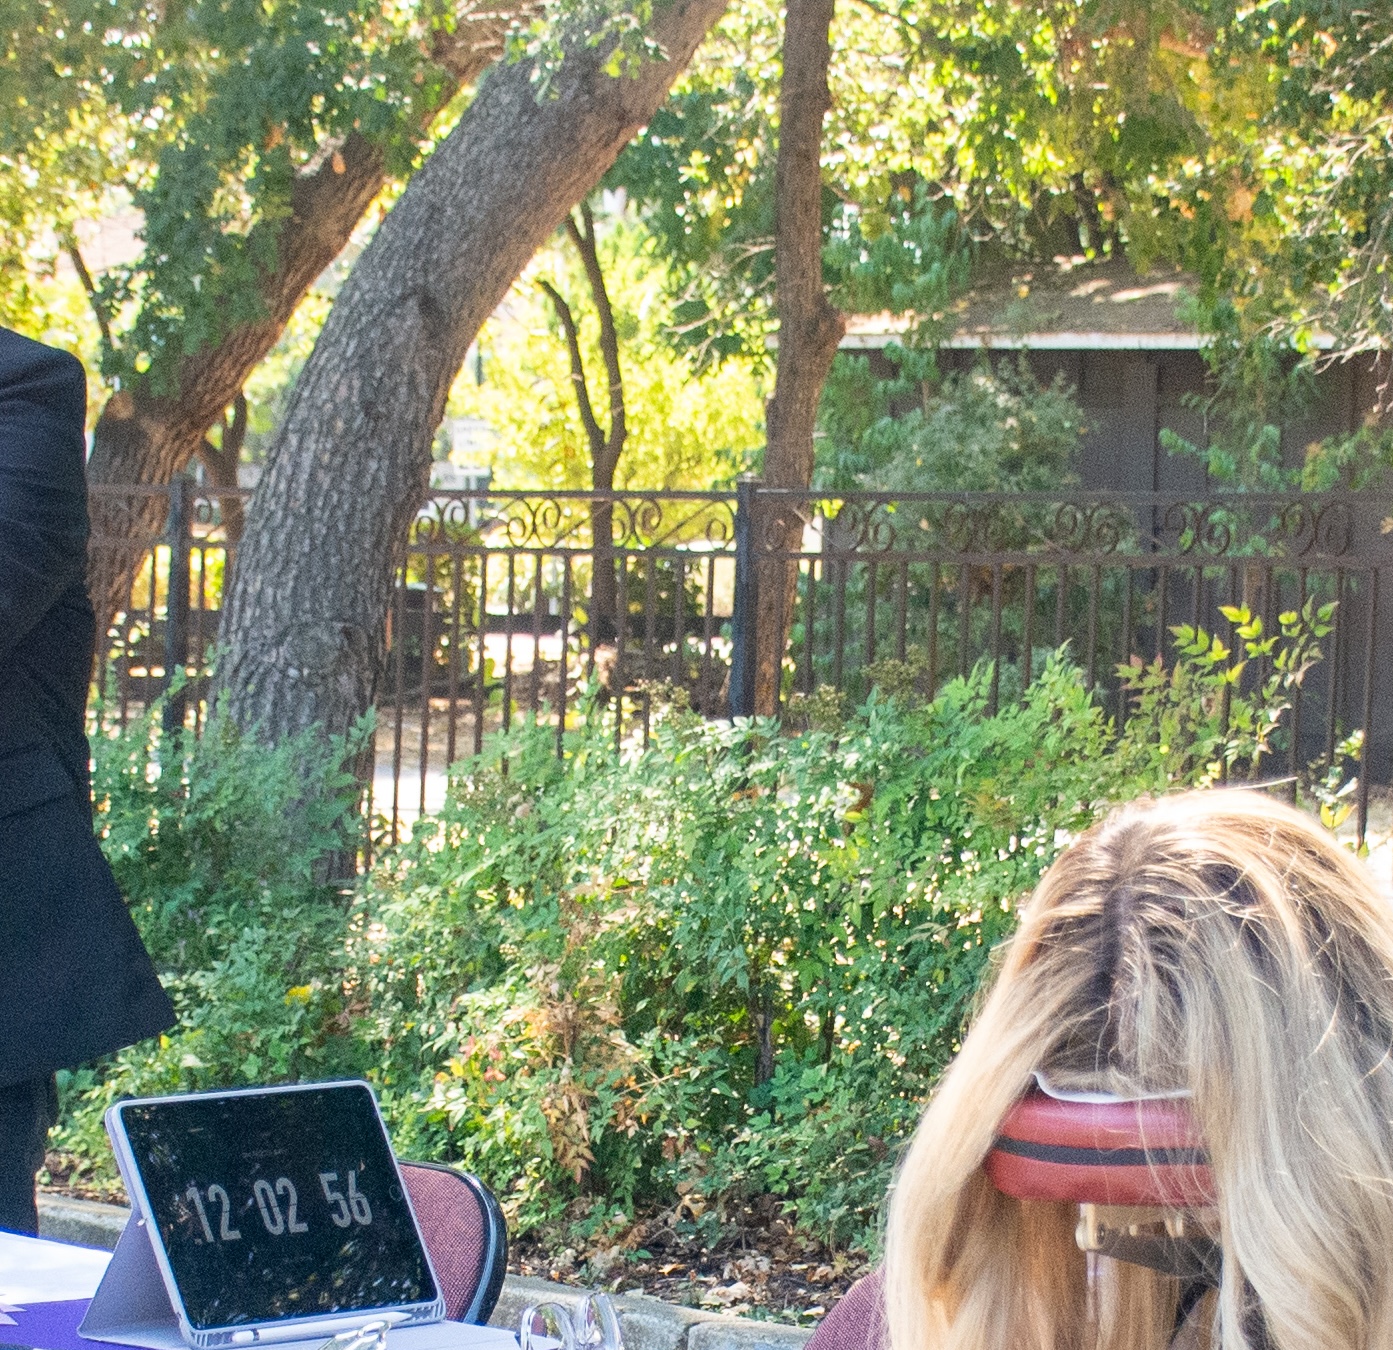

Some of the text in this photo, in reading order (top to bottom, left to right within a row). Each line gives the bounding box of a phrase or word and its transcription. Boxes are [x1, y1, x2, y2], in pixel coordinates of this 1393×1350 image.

[186, 1169, 373, 1243] 12 02 56
